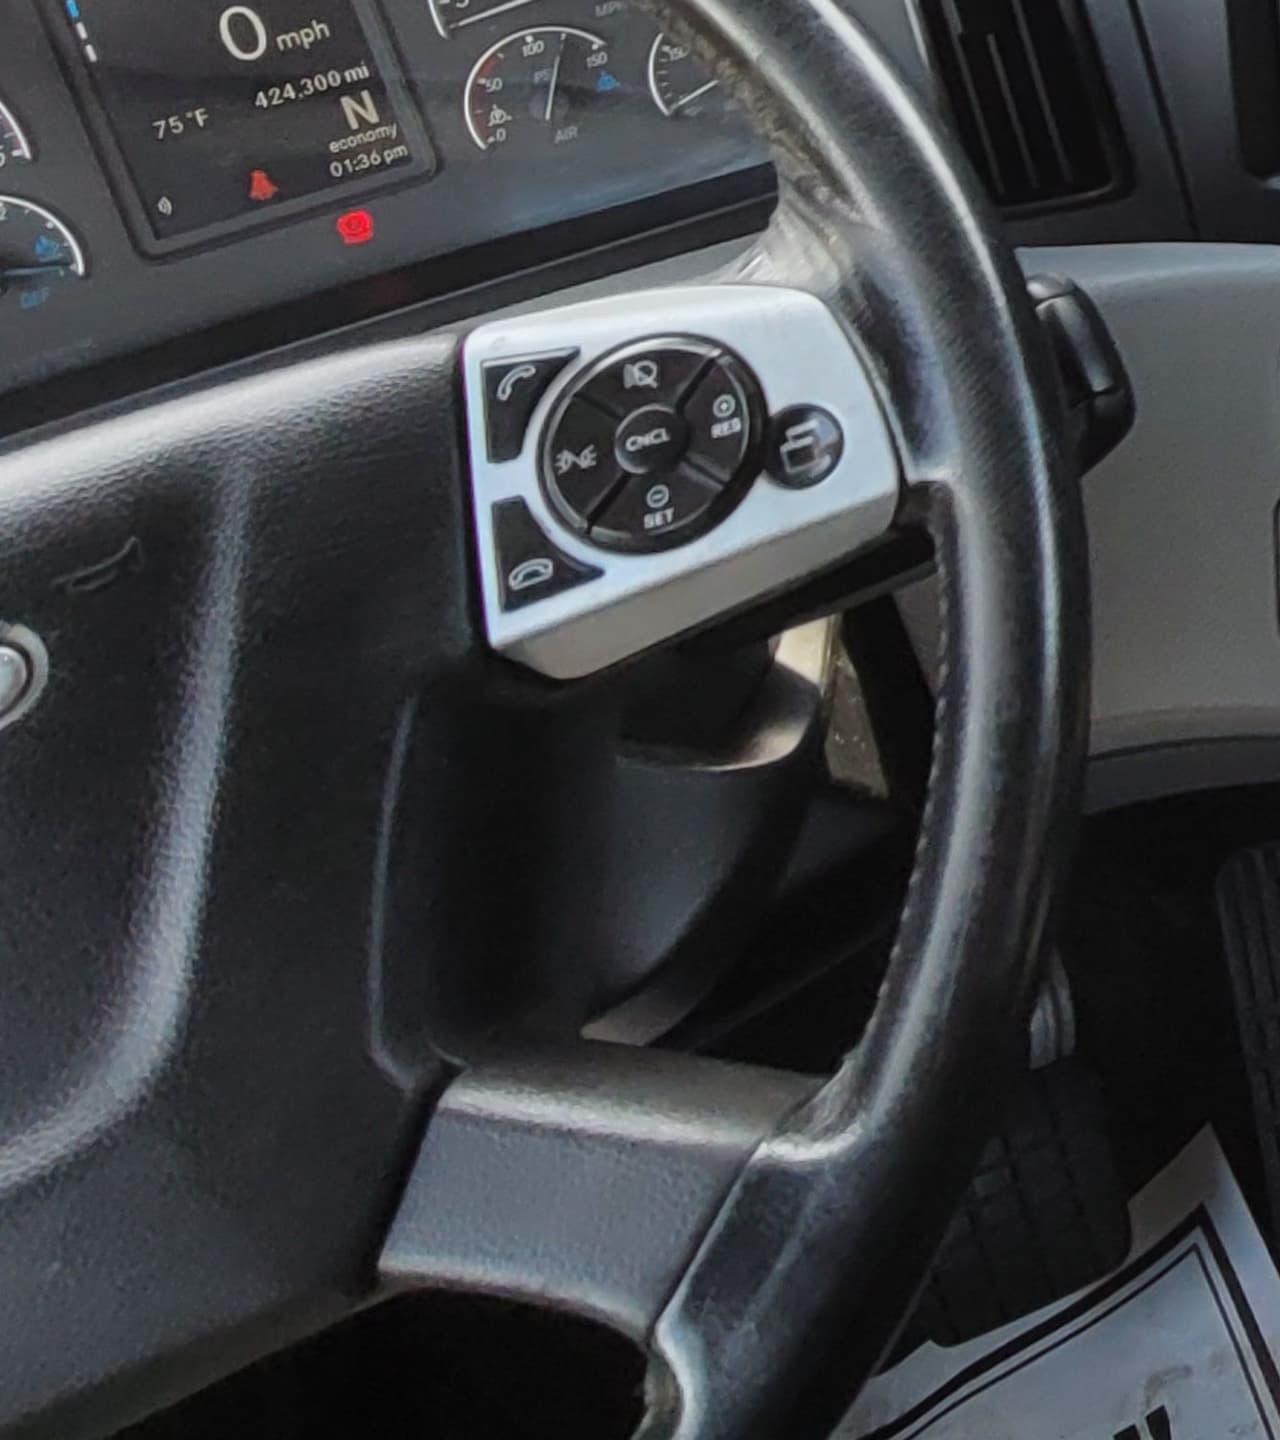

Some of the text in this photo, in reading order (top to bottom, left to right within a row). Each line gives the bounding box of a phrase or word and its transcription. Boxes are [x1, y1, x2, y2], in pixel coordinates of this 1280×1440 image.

[218, 5, 331, 61] 0 mph
[521, 39, 545, 58] 100
[343, 60, 370, 85] mi
[485, 77, 503, 93] 50
[339, 89, 381, 131] N
[328, 122, 399, 154] economy
[554, 125, 579, 143] AIR
[328, 143, 409, 179] 01:36 pm
[624, 426, 672, 452] CNCL
[710, 416, 742, 440] RES
[642, 506, 676, 530] SET
